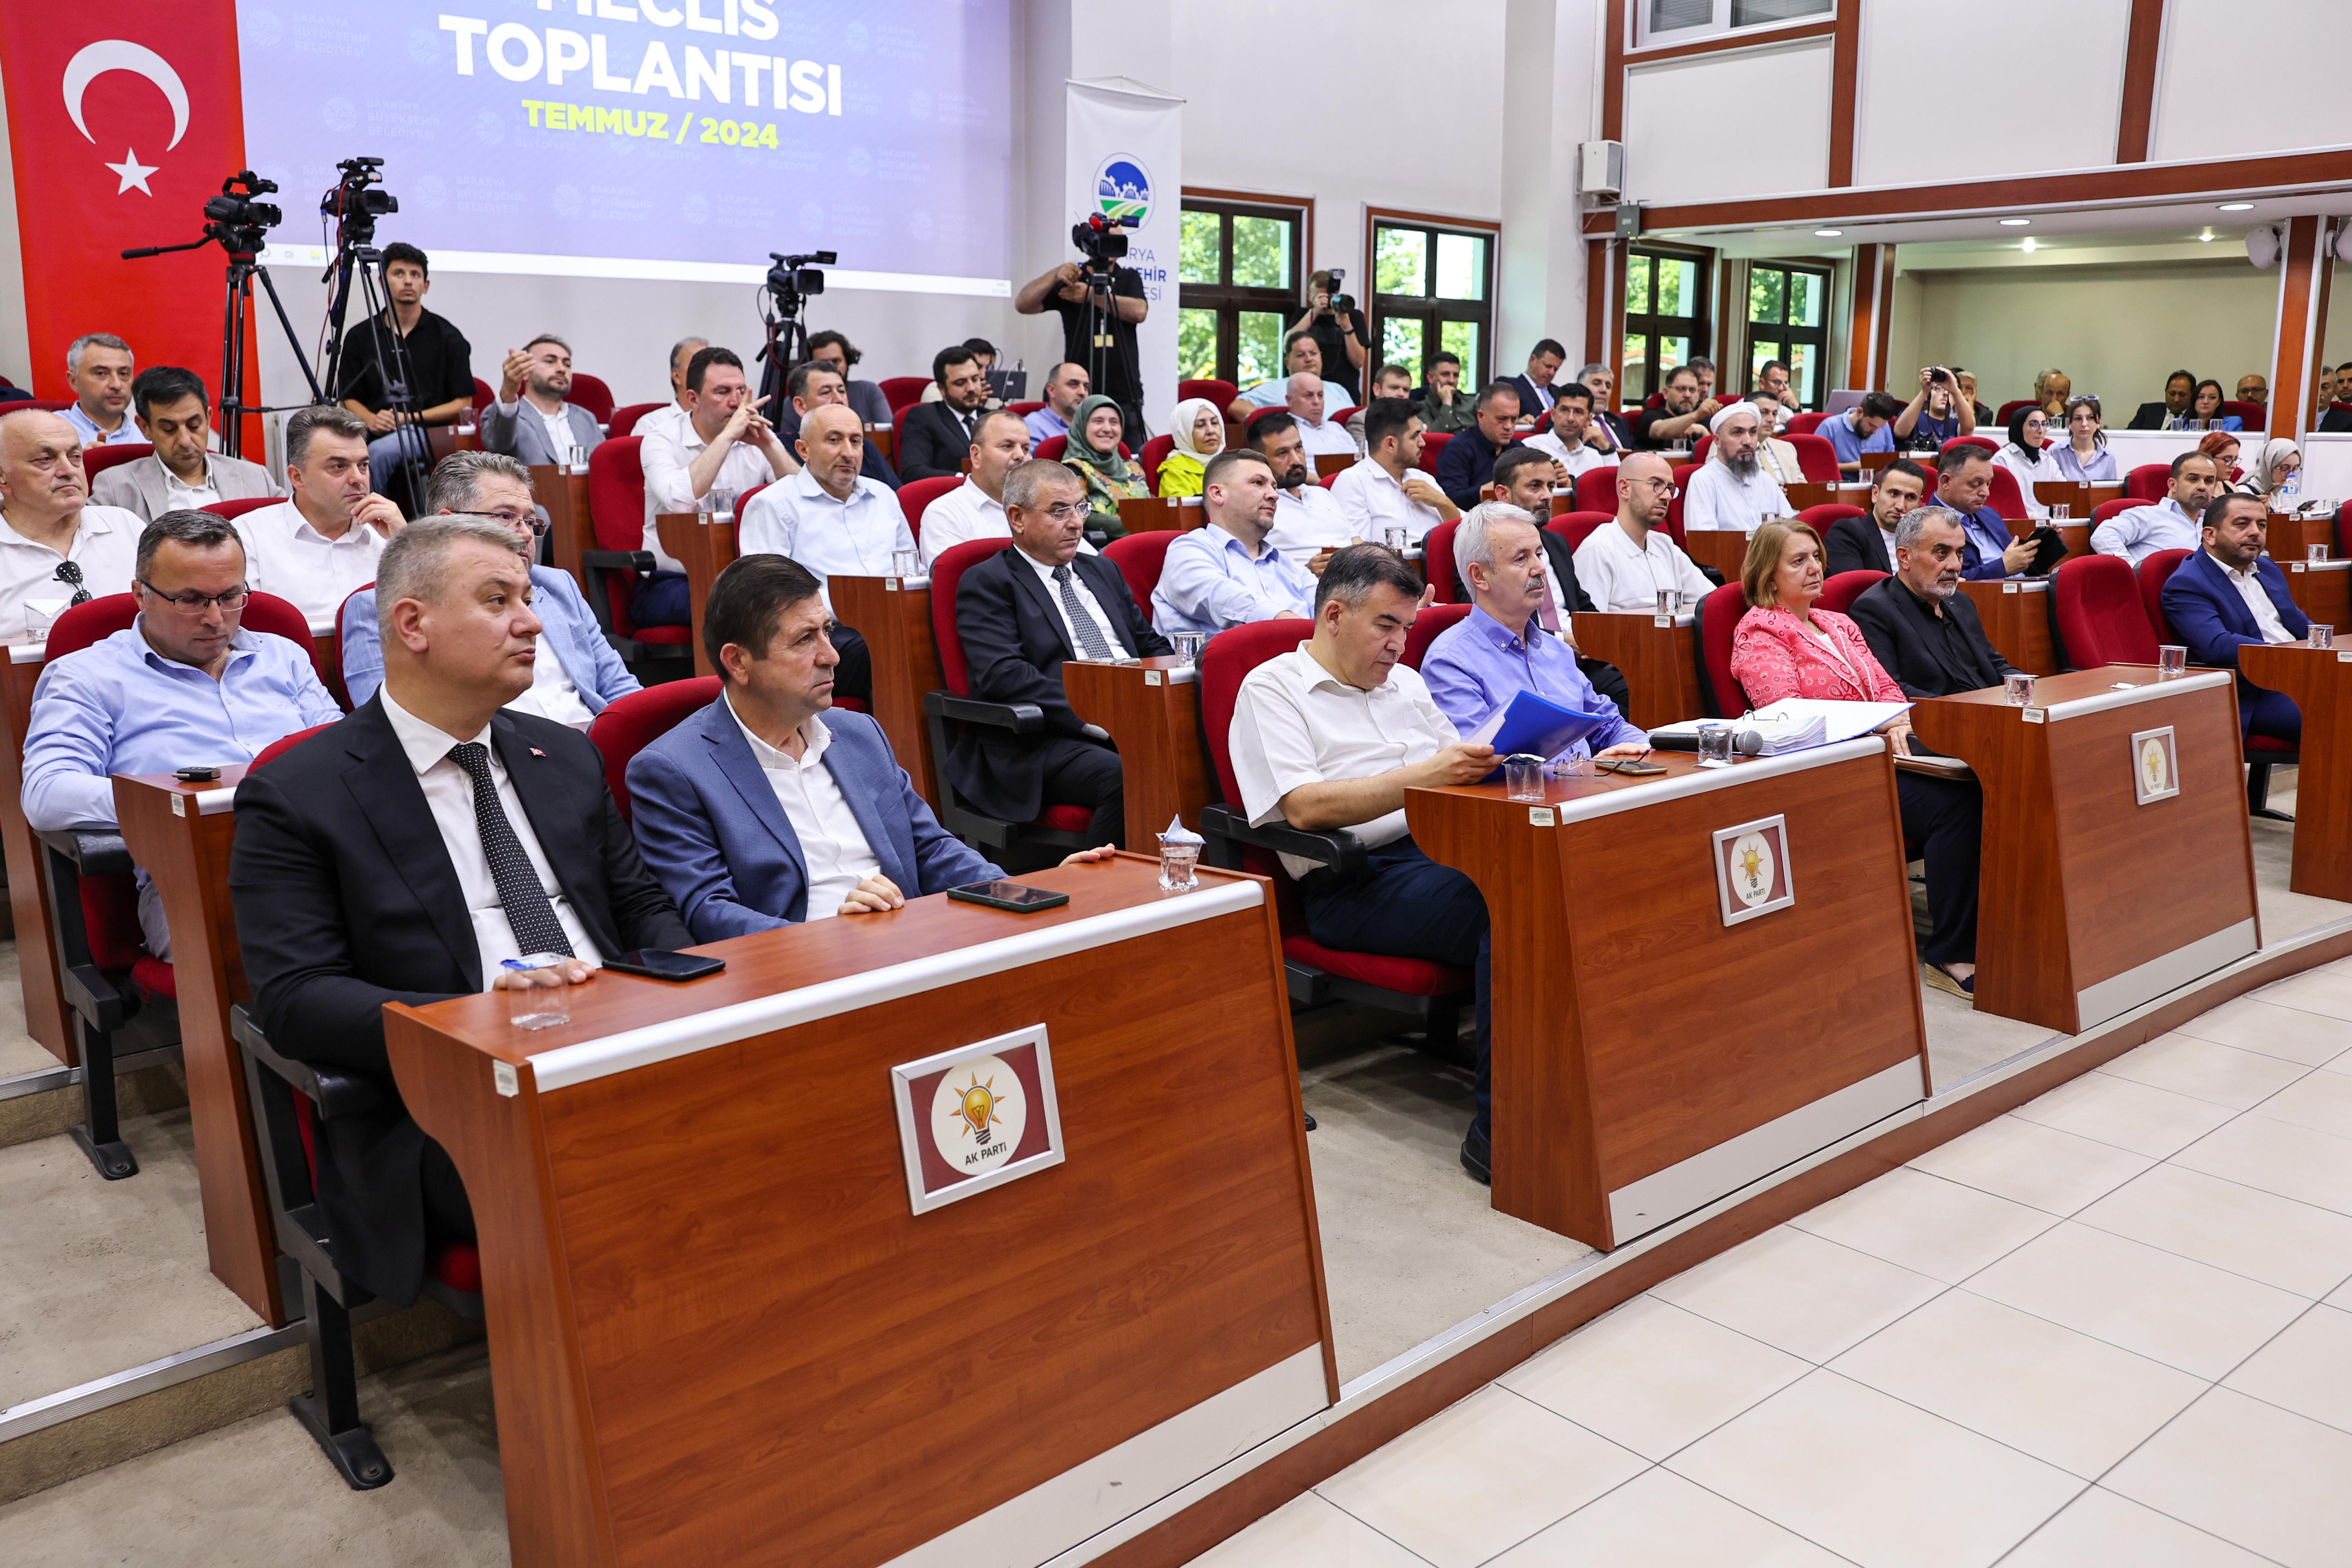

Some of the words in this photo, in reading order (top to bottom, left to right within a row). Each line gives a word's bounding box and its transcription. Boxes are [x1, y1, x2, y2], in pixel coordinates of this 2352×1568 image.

[292, 12, 349, 28] SAKARYA
[439, 14, 842, 116] TOPLANTISI
[521, 100, 668, 138] TEMMUZ
[700, 118, 779, 149] 2024
[1753, 888, 1765, 897] PARTİ
[966, 1151, 978, 1166] AK
[981, 1142, 1006, 1159] PARTİ
